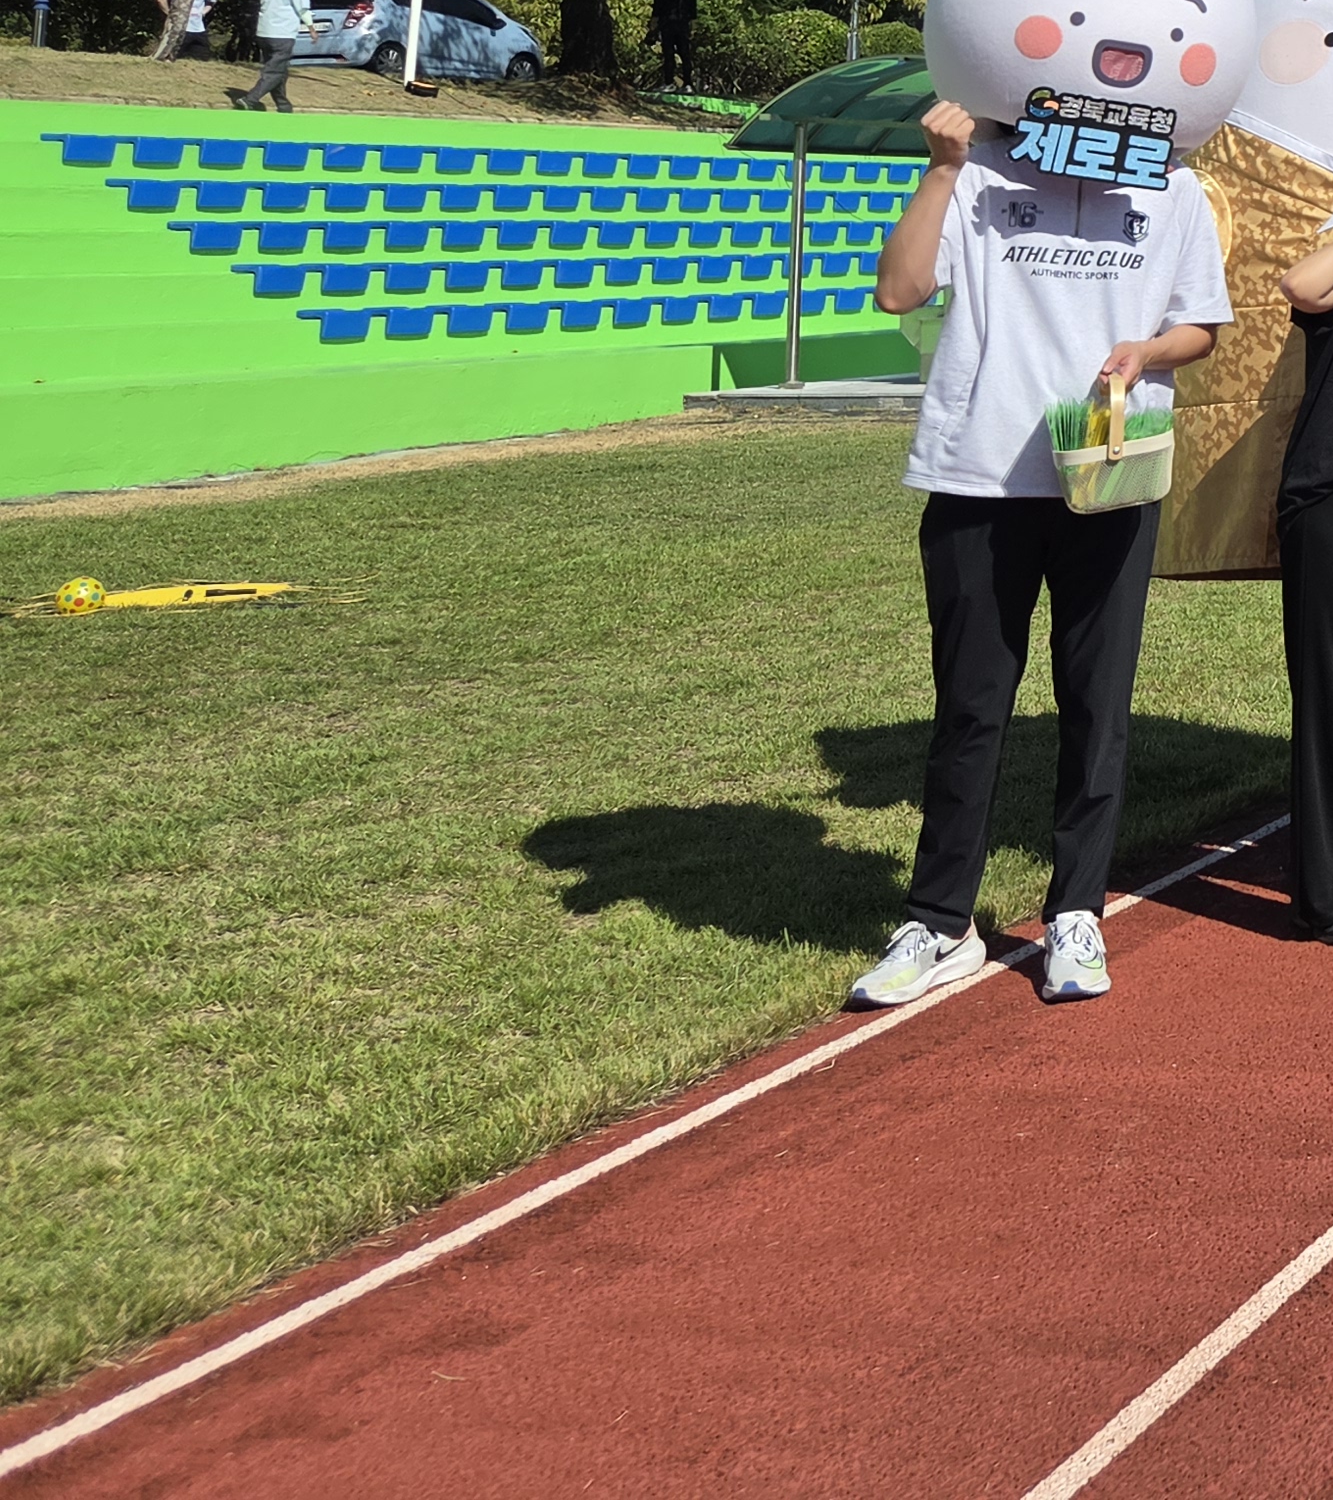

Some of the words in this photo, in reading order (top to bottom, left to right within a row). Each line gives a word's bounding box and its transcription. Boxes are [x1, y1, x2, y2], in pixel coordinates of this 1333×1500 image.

[1059, 96, 1175, 134] 경북교육청
[1010, 120, 1171, 189] 제로로
[1001, 246, 1094, 267] ATHLETIC
[1096, 250, 1145, 270] CLUB
[1030, 269, 1083, 280] AUTHENTIC
[1085, 271, 1119, 280] SPORTS
